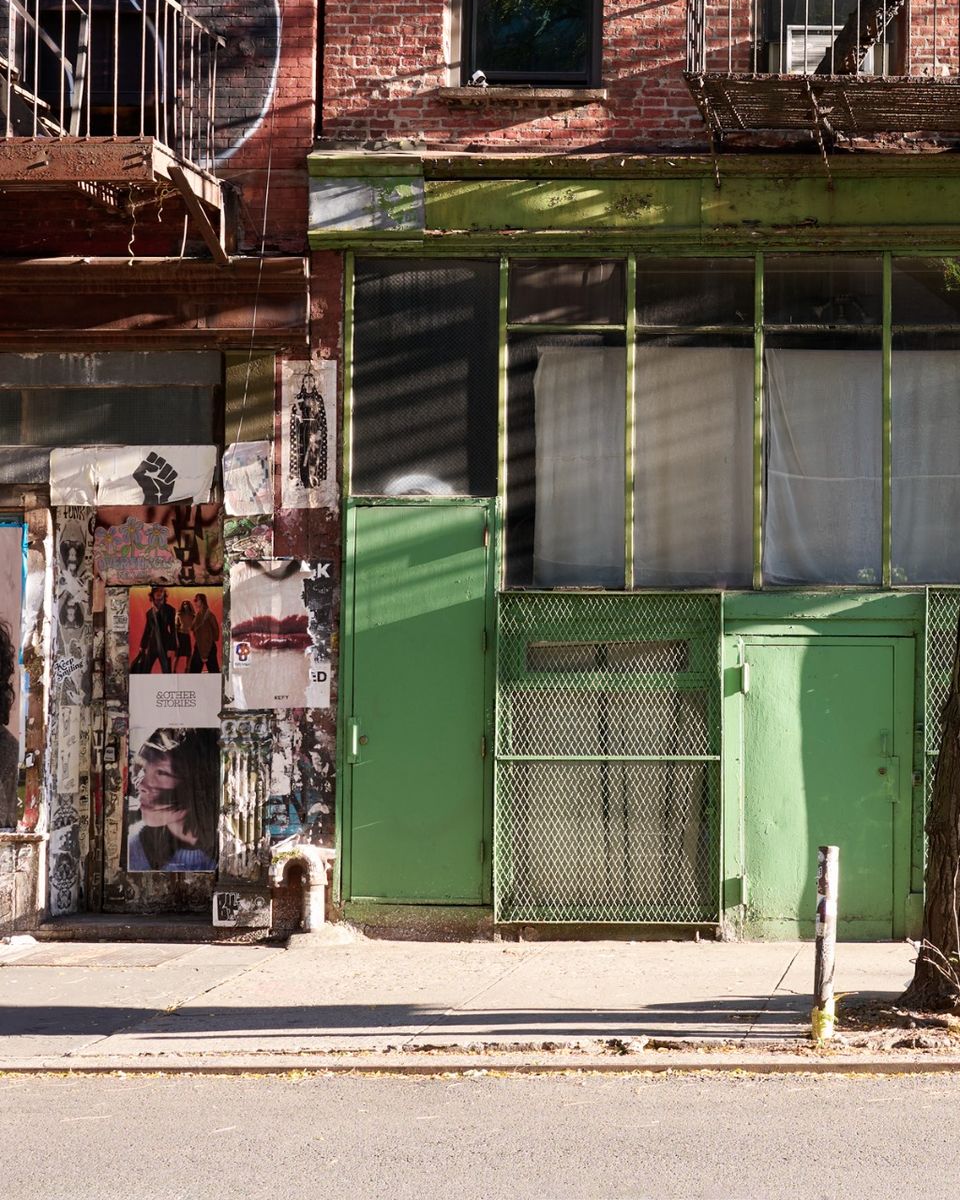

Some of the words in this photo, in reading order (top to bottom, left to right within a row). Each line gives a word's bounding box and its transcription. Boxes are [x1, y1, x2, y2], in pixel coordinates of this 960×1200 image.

[55, 658, 74, 671] Keep
[57, 661, 84, 681] Smiling
[156, 700, 197, 708] STORIES
